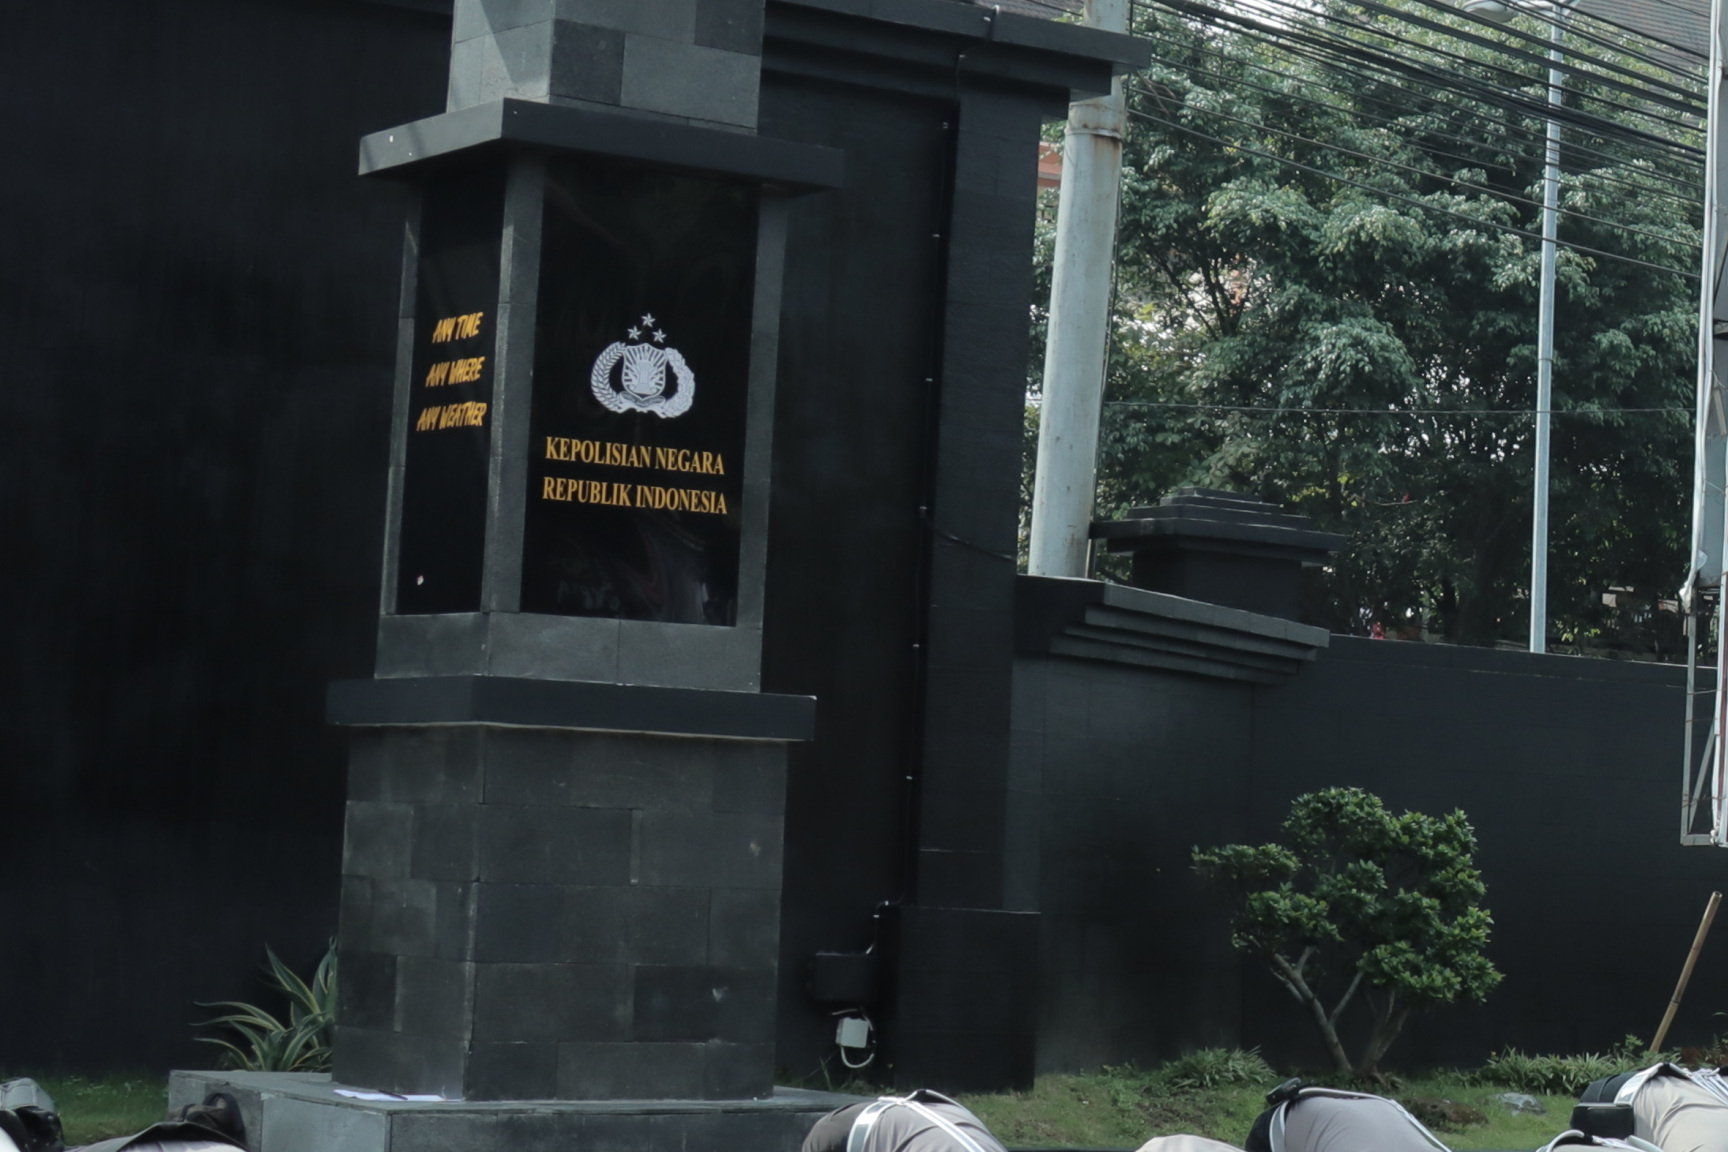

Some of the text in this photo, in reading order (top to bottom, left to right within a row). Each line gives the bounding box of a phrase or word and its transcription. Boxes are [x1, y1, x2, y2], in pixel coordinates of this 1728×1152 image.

[433, 312, 483, 343] ANY TIME
[426, 356, 485, 387] ANY WHERE
[417, 401, 487, 431] ANY WEATHER
[546, 436, 724, 475] KEPOLISIAN NEGARA
[542, 477, 728, 515] REPUBLIK INDONESIA
